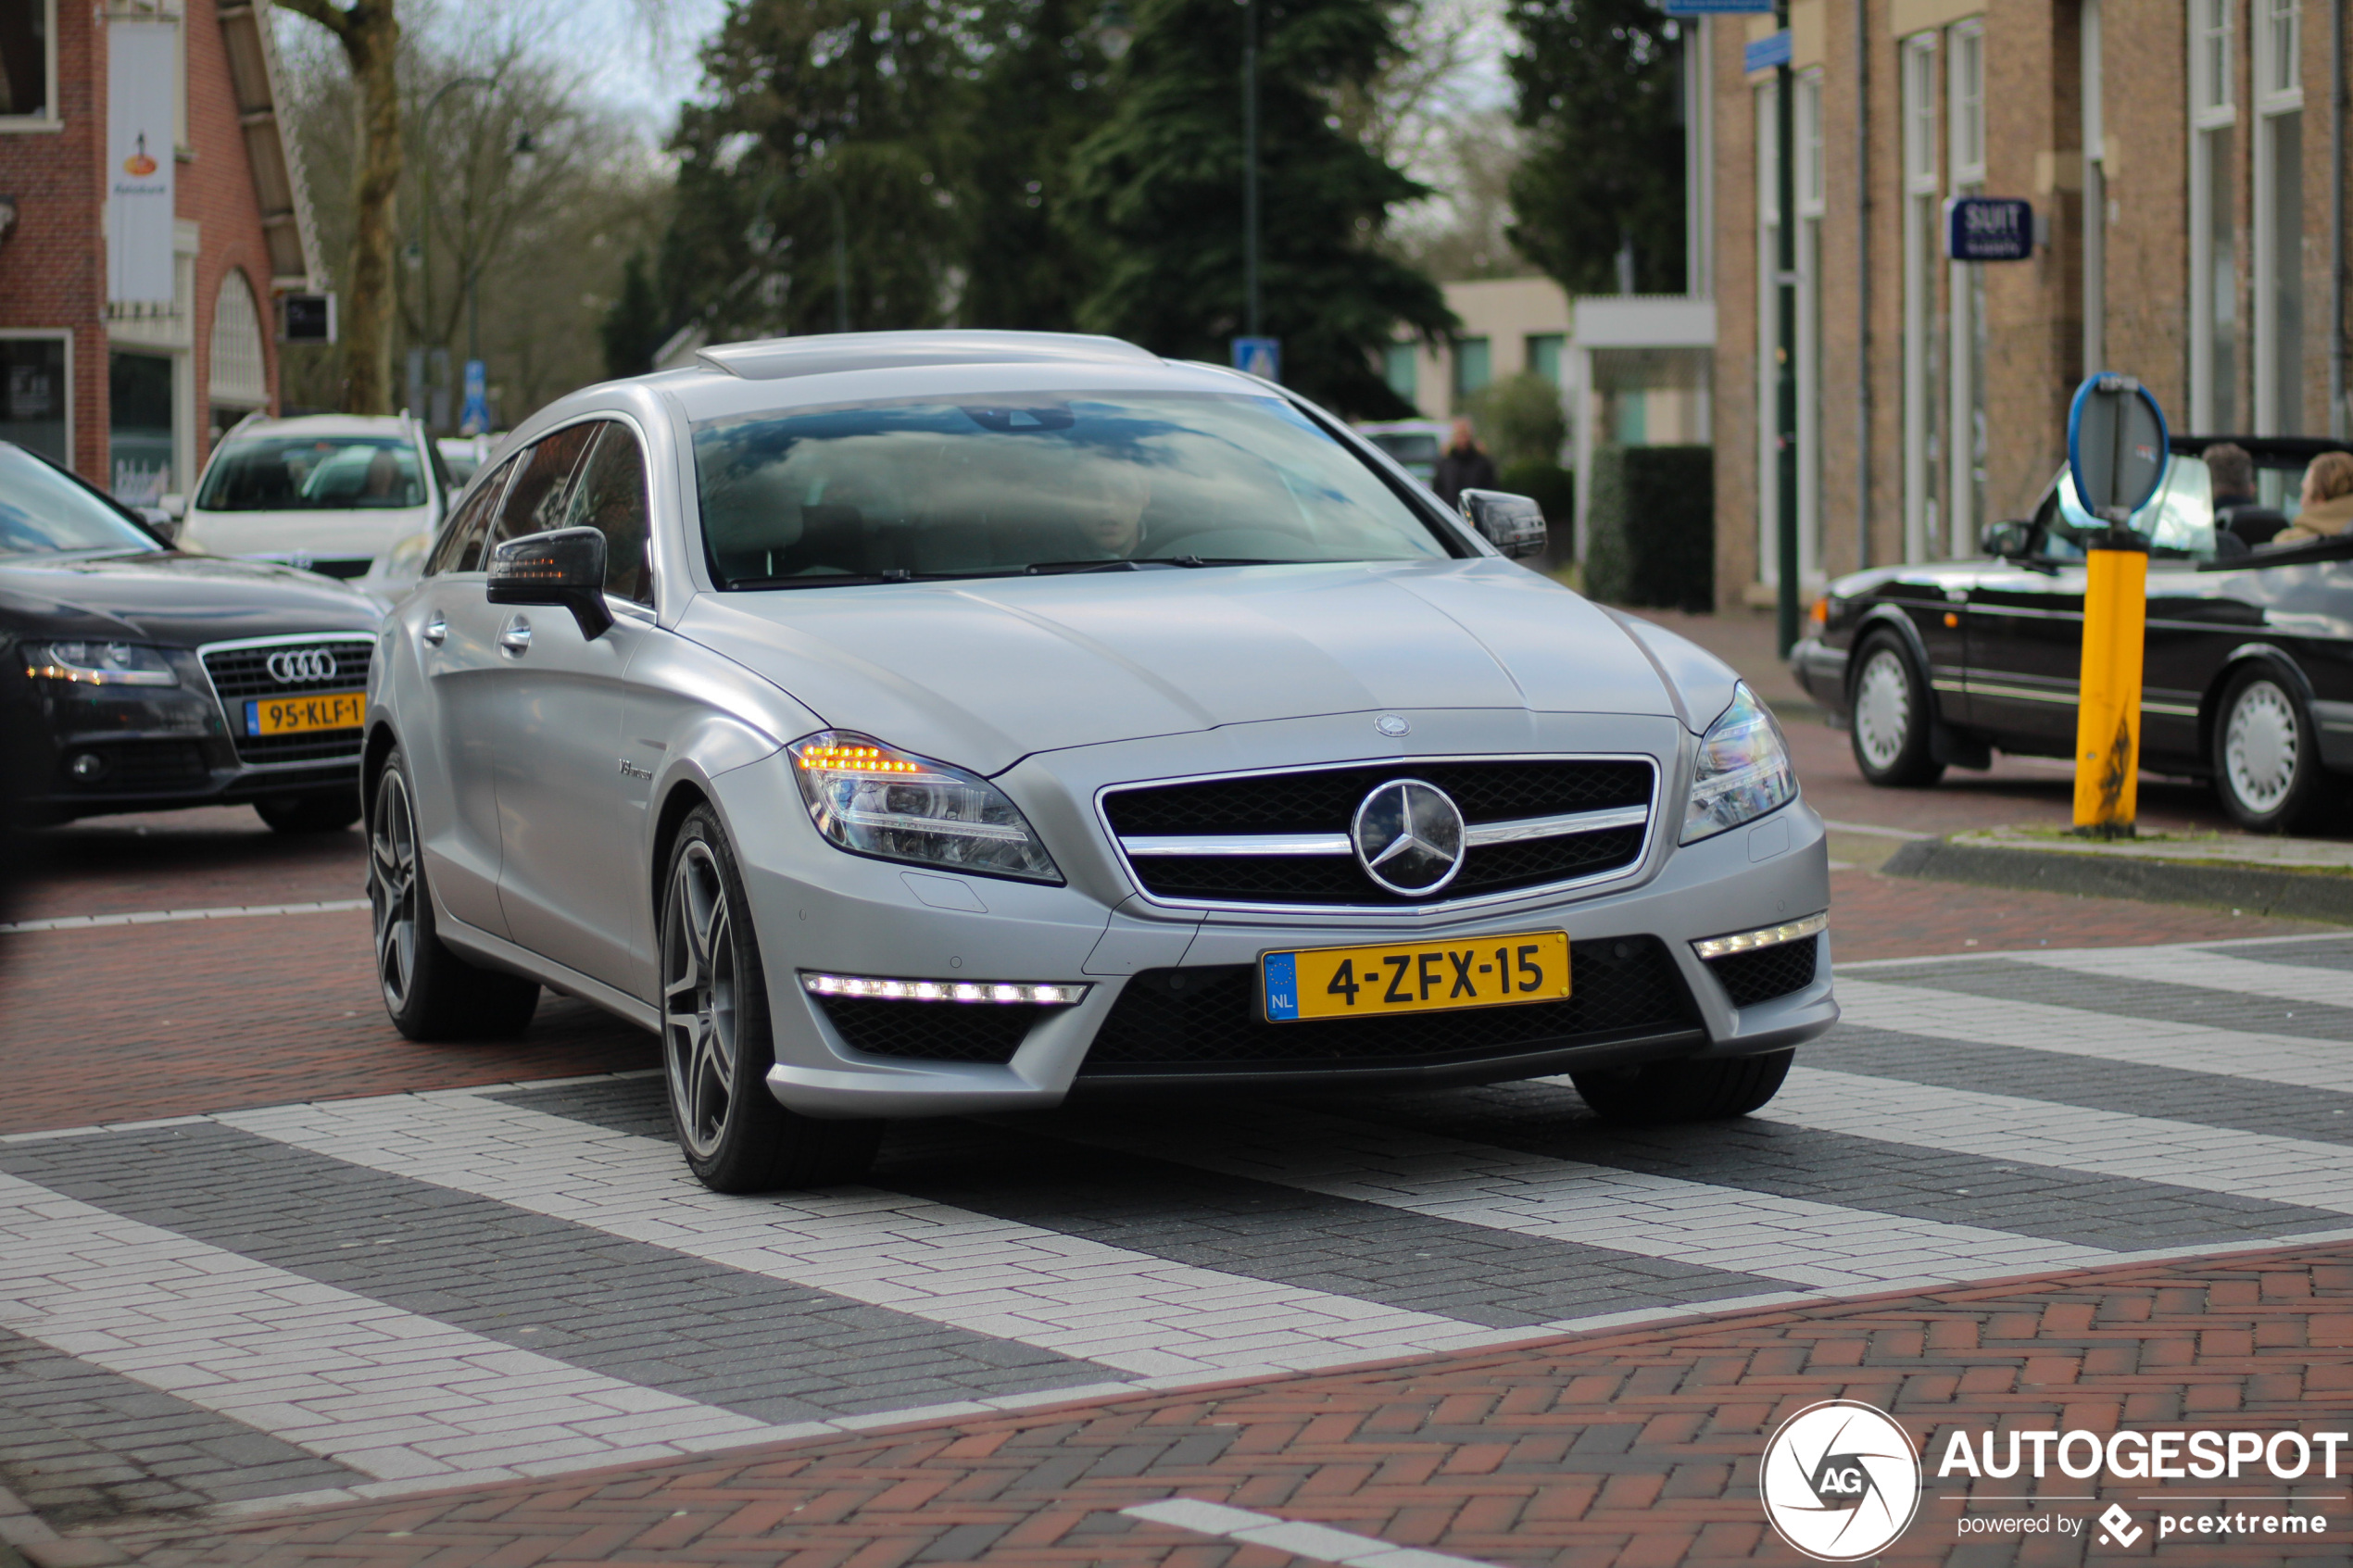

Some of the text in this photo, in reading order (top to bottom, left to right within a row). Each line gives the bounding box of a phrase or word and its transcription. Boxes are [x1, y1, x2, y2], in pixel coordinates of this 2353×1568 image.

[1966, 204, 2020, 233] SUIT
[1327, 944, 1544, 1006] 4-ZFX-15
[1271, 994, 1294, 1009] NL
